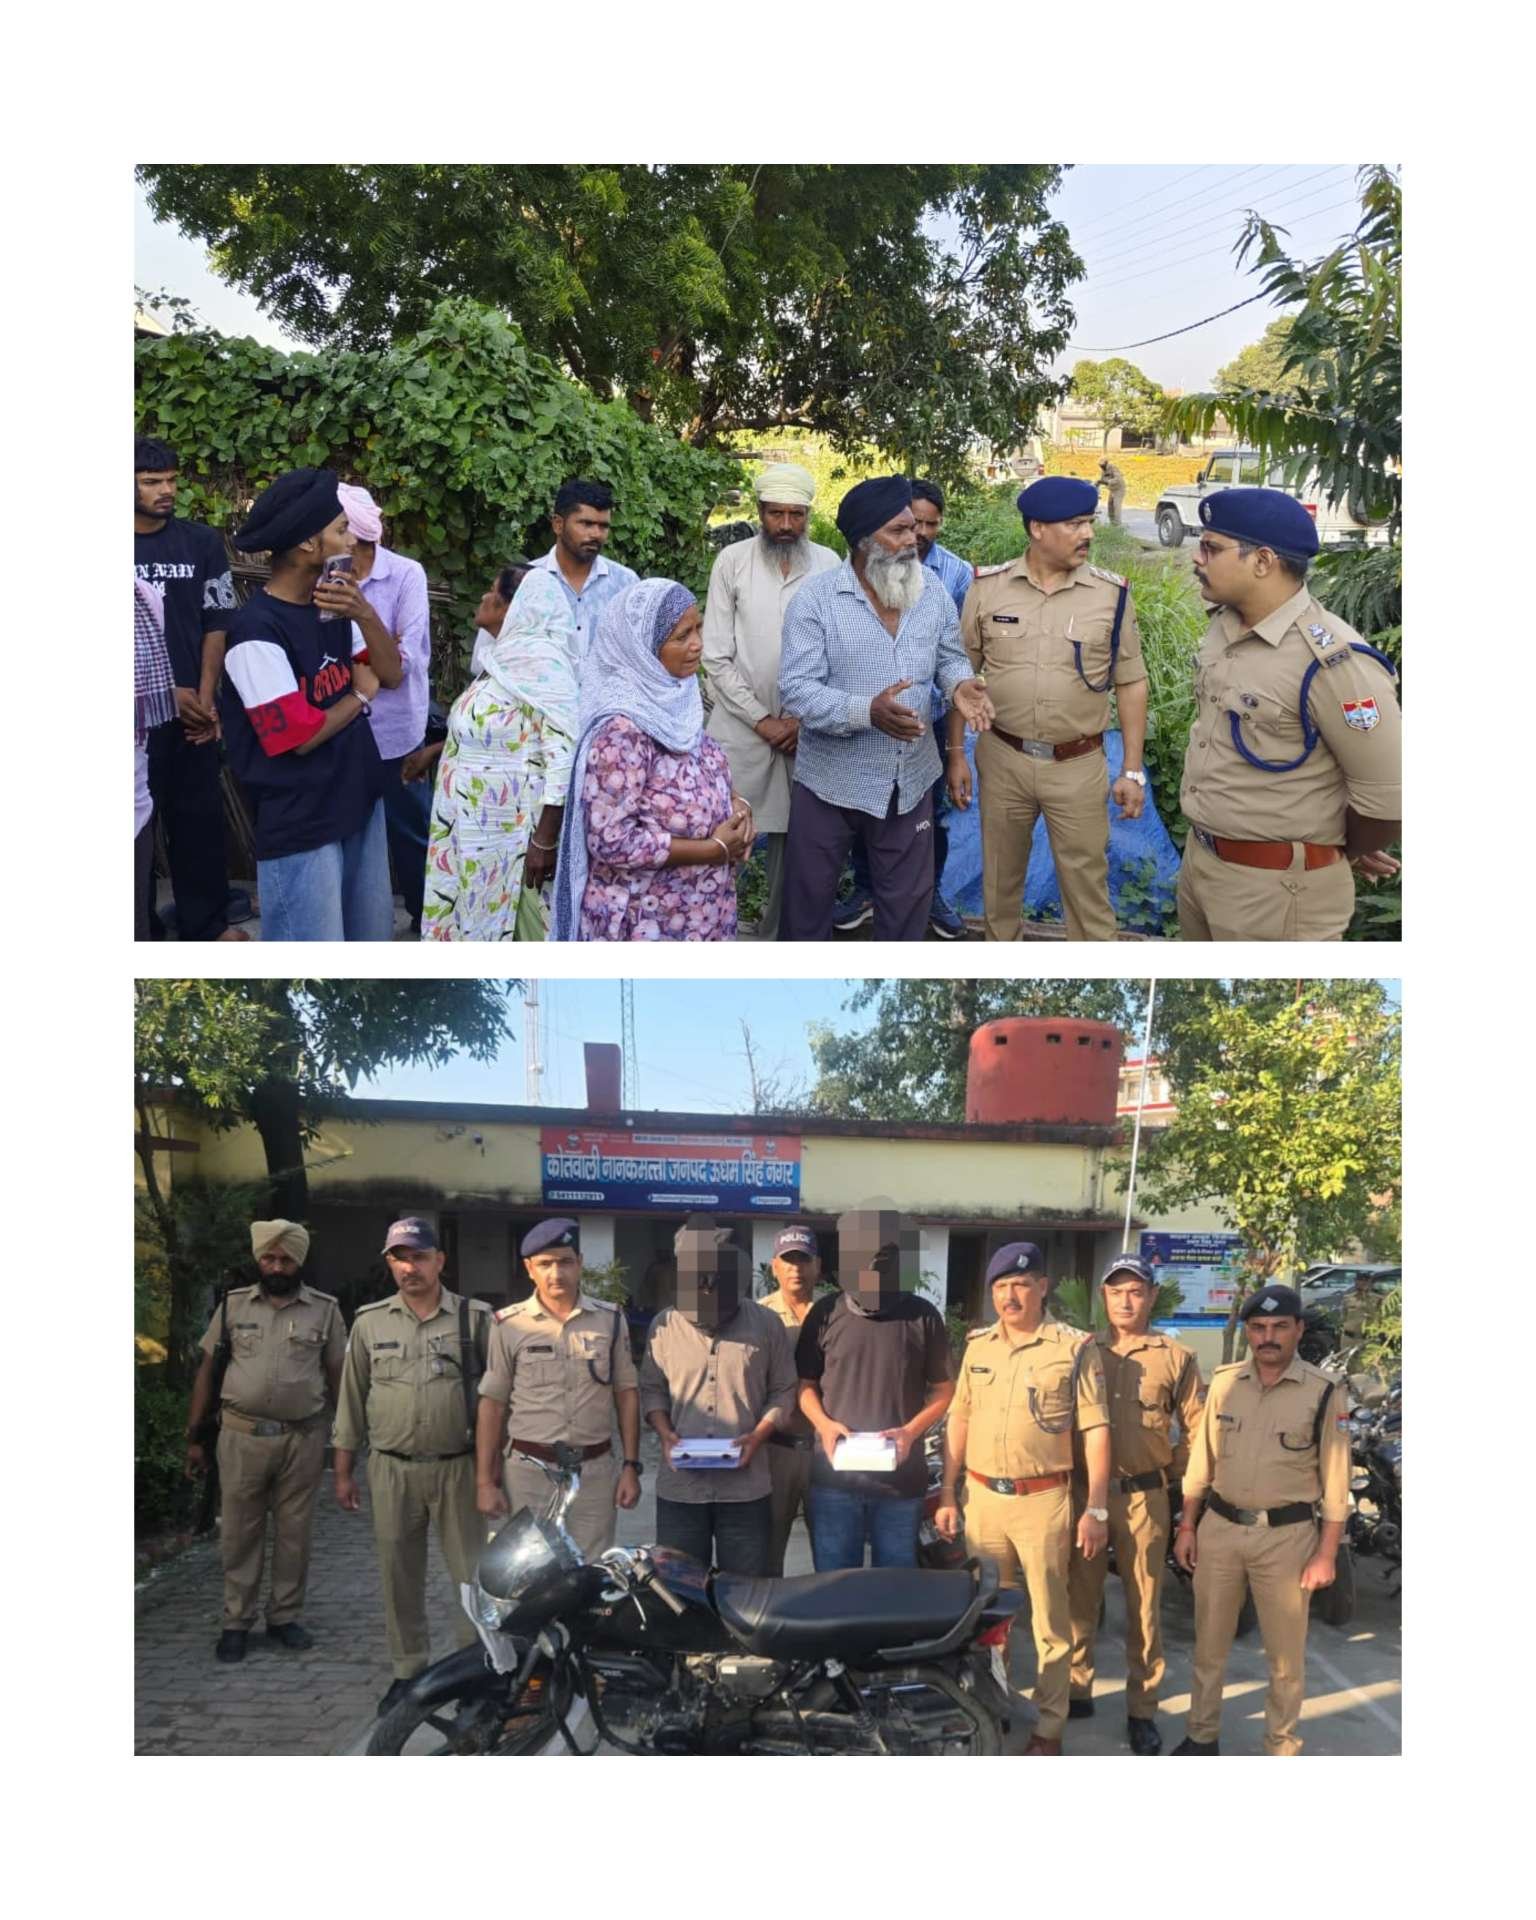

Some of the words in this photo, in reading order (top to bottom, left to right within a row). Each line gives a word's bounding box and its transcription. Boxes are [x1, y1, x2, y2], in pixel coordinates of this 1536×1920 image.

[546, 1143, 600, 1180] कोतवाली
[602, 1155, 667, 1181] नानकमत्ता
[668, 1157, 708, 1183] जनपद
[740, 1149, 766, 1187] सिंह
[765, 1160, 794, 1186] नगर
[780, 1231, 810, 1245] POLICE
